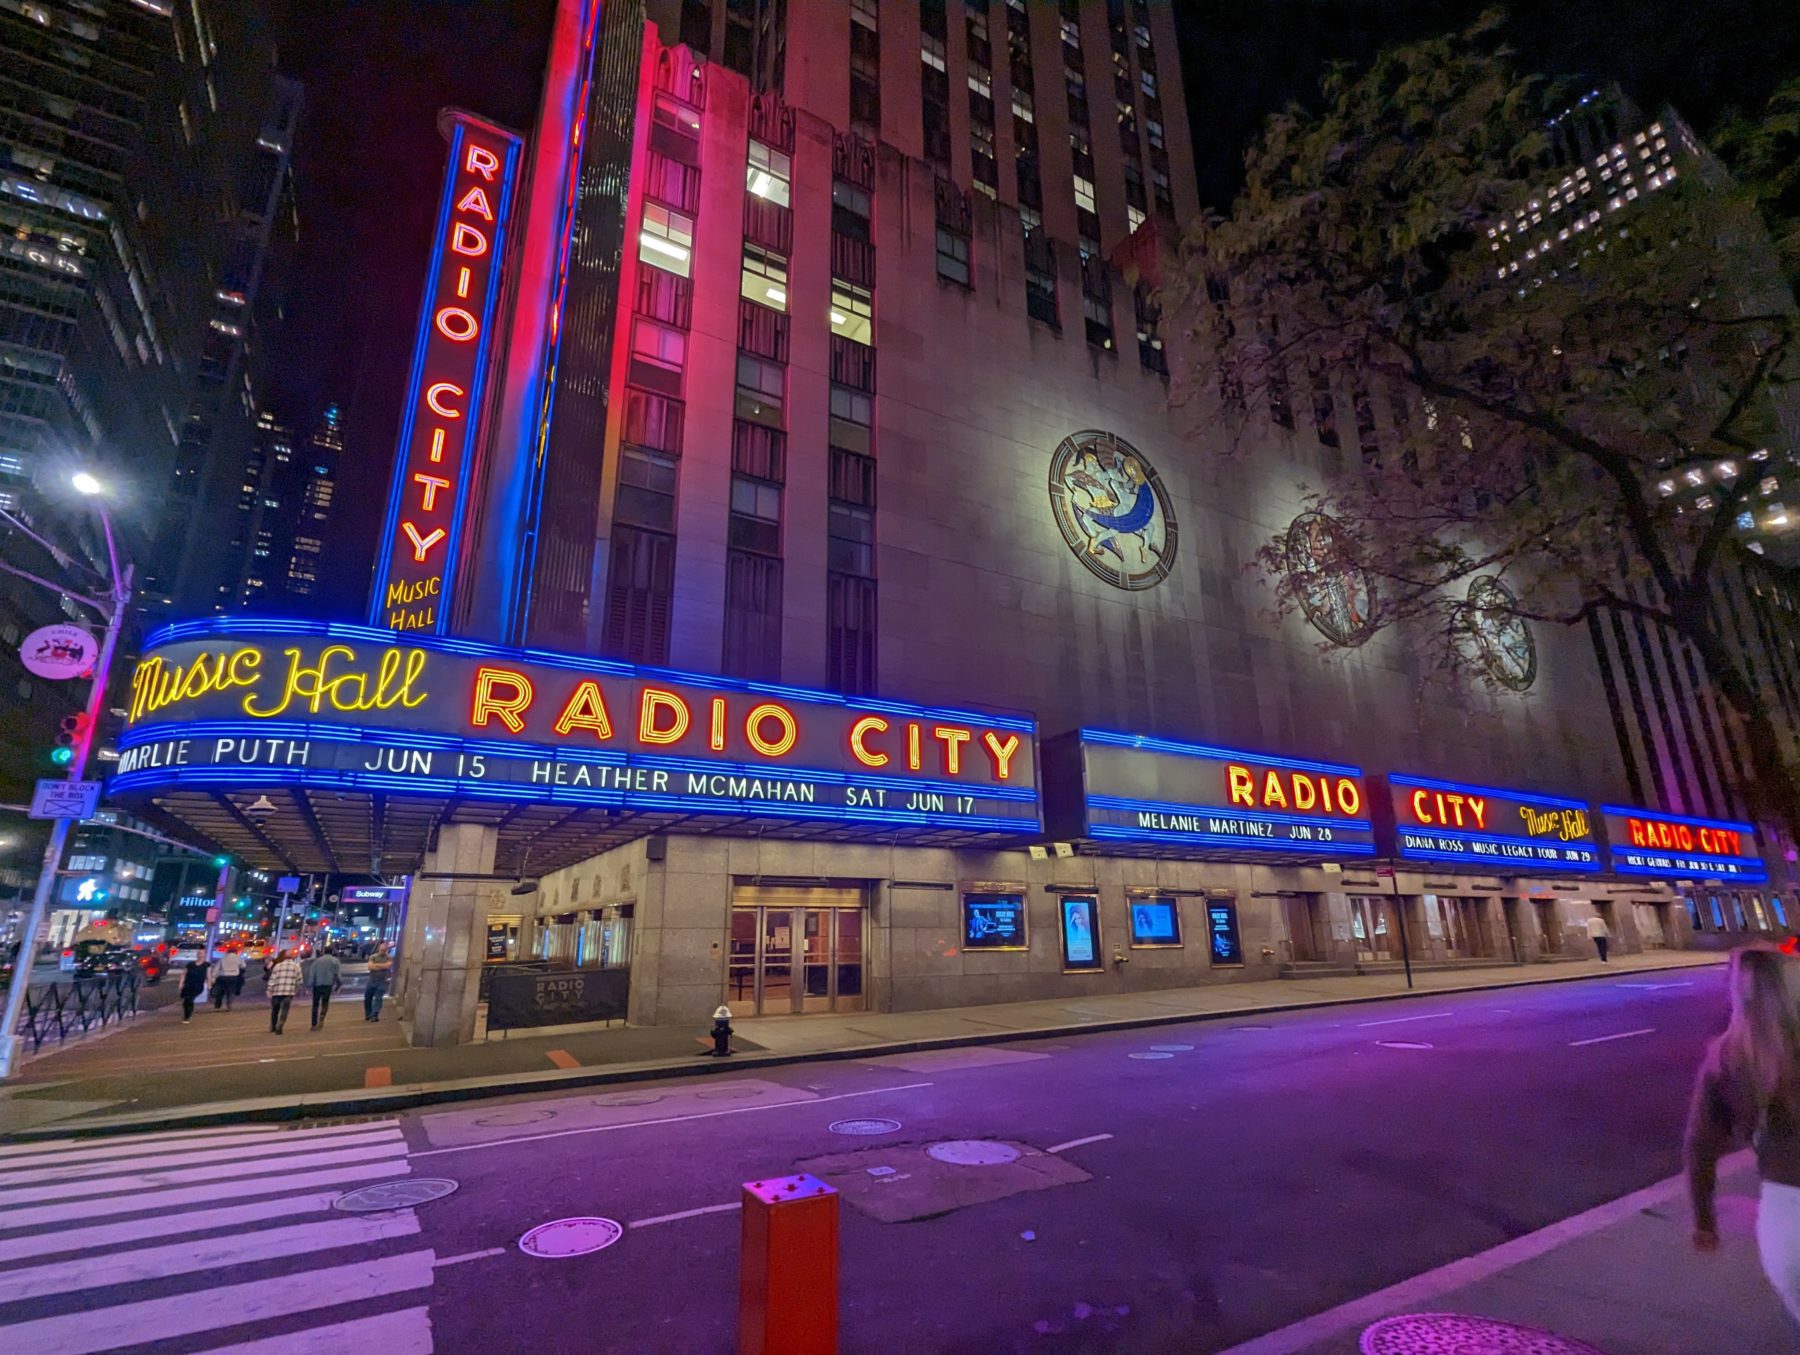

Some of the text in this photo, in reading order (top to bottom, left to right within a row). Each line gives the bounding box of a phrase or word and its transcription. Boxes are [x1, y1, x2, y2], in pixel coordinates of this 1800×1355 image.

[402, 143, 499, 563] RADIO CITY
[387, 576, 441, 608] MUSIC
[390, 607, 435, 631] HALL
[129, 645, 428, 723] Music Hall
[471, 666, 1020, 779] RADIO CITY
[214, 738, 309, 765] PUTH
[364, 748, 432, 774] JUN
[457, 755, 486, 778] 15
[532, 761, 669, 791] HEATHER
[688, 773, 815, 803] MCMAHAN
[846, 787, 887, 807] SAT
[906, 793, 944, 812] JUN
[958, 797, 974, 815] 17
[1227, 764, 1360, 815] RADIO
[1139, 811, 1332, 841] MELANIE MARTINEZ JUN 28
[1412, 789, 1590, 841] CITY Music Hall
[1405, 835, 1435, 850] DIANA
[1439, 838, 1464, 853] ROSS
[1472, 841, 1498, 856] MUSIC
[1502, 844, 1533, 859] LEGACY
[1537, 847, 1558, 860] TOUR
[1565, 849, 1579, 862] JUN
[1628, 817, 1741, 855] RADIO CITY
[356, 890, 384, 898] Subway
[536, 989, 584, 1001] CITY
[537, 980, 585, 992] RADIO
